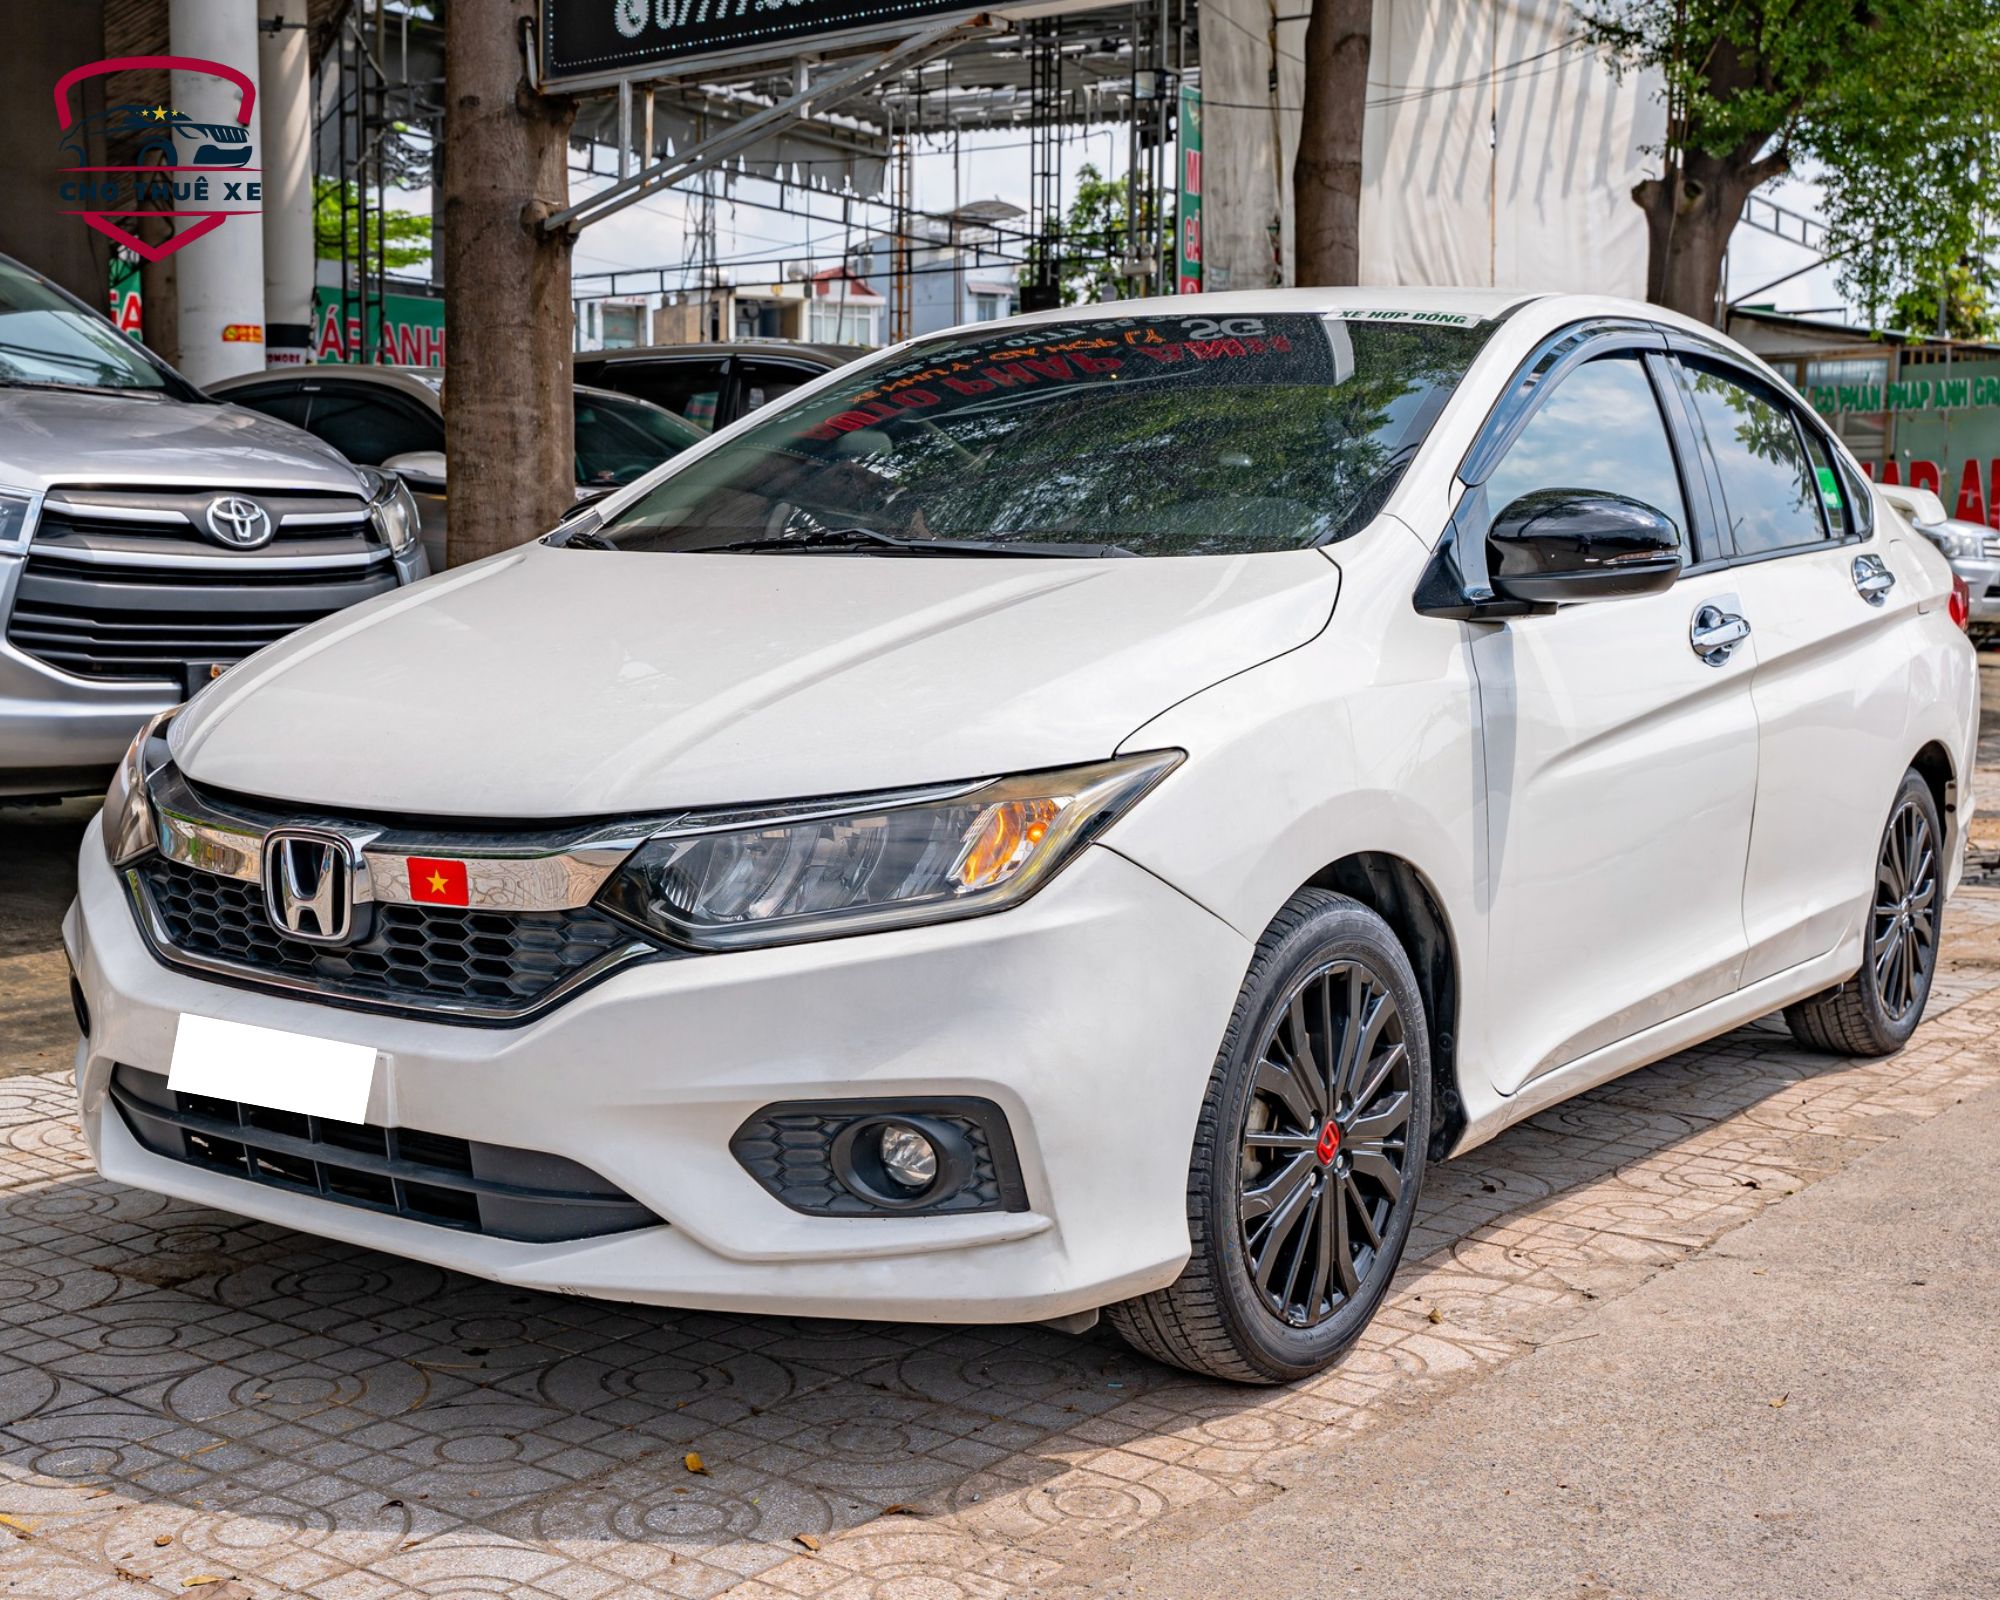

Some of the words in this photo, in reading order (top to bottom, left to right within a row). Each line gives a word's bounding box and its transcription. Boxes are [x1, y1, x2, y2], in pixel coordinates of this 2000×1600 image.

[1339, 310, 1365, 318] XE
[374, 321, 446, 368] ANH
[1973, 375, 2000, 408] GR
